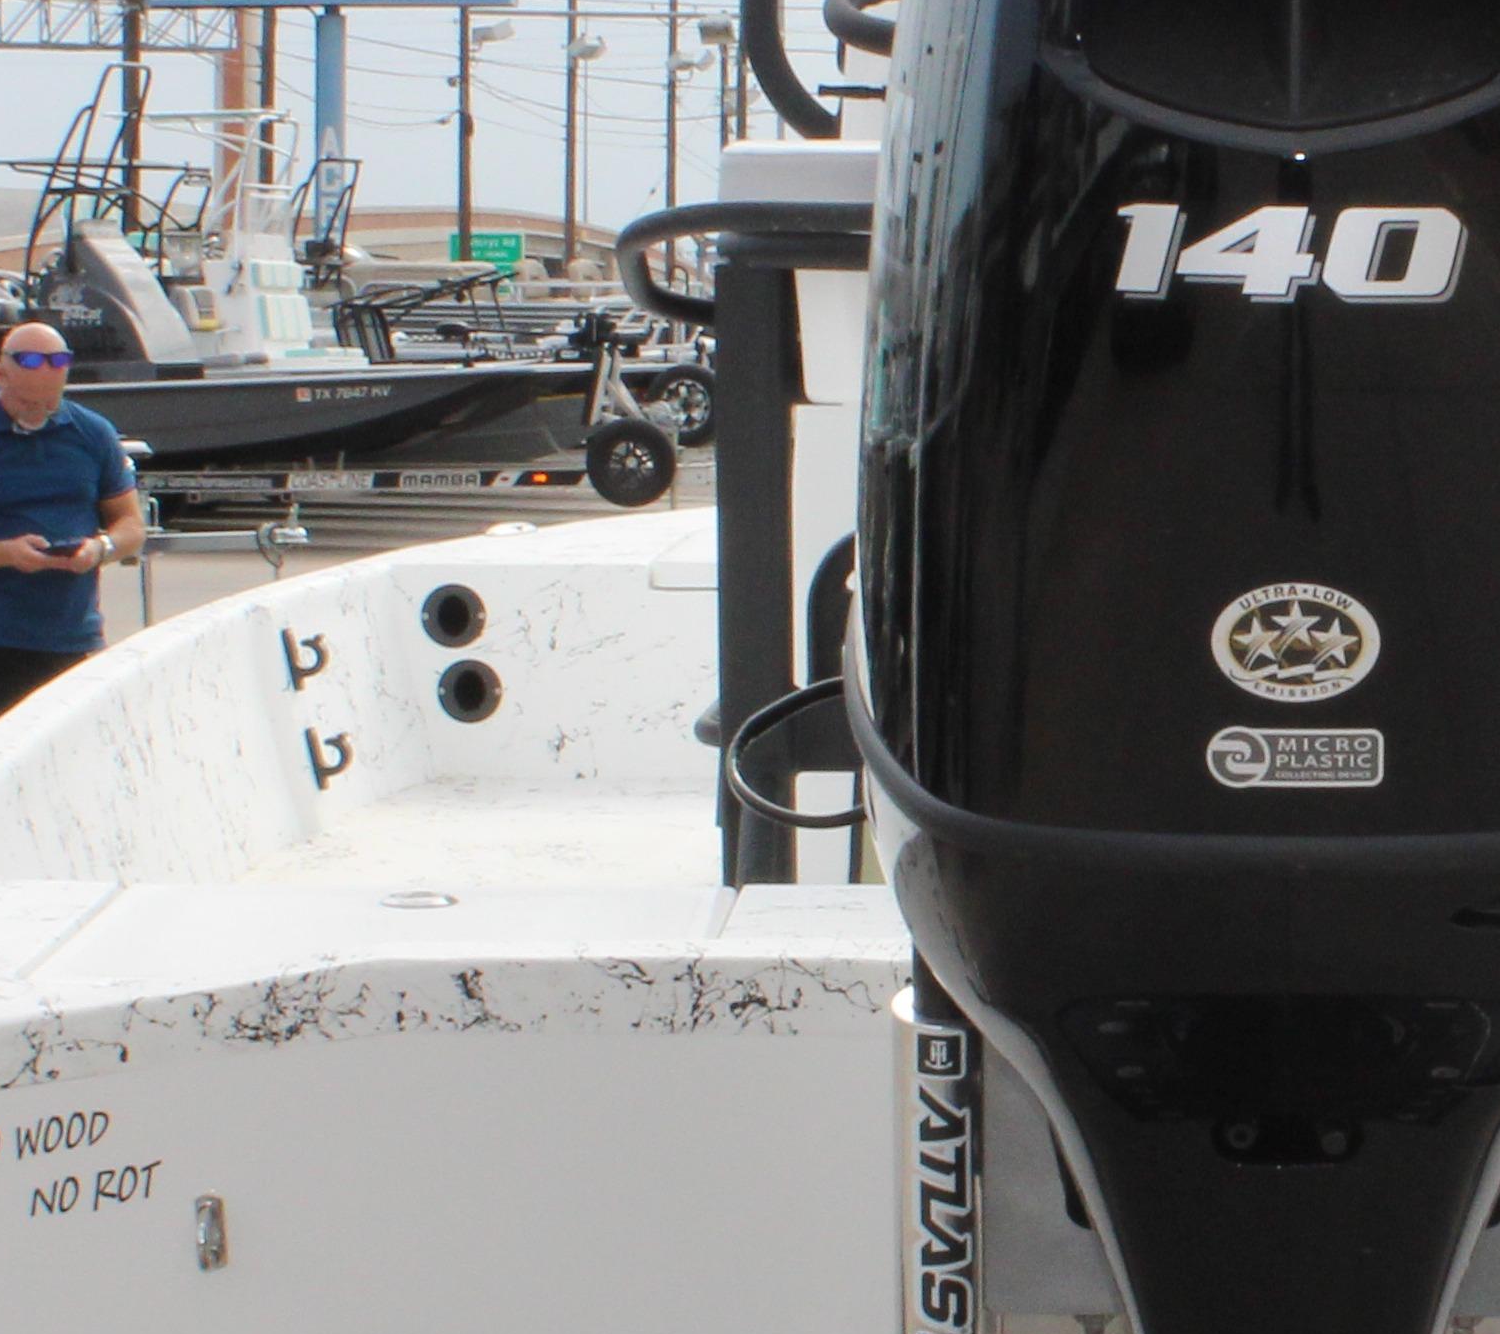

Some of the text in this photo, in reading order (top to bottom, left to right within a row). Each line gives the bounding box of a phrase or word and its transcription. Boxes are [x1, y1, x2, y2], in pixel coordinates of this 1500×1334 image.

[1116, 203, 1468, 303] 140
[403, 474, 477, 487] MAMBA
[1240, 584, 1352, 610] ULTRA LOW
[1254, 681, 1341, 697] EMISSION
[1278, 737, 1372, 752] MICRO
[1275, 754, 1372, 768] PLASTIC
[15, 1111, 110, 1160] WOOD
[30, 1159, 162, 1216] NO ROT
[919, 1085, 968, 1328] ATLAS
